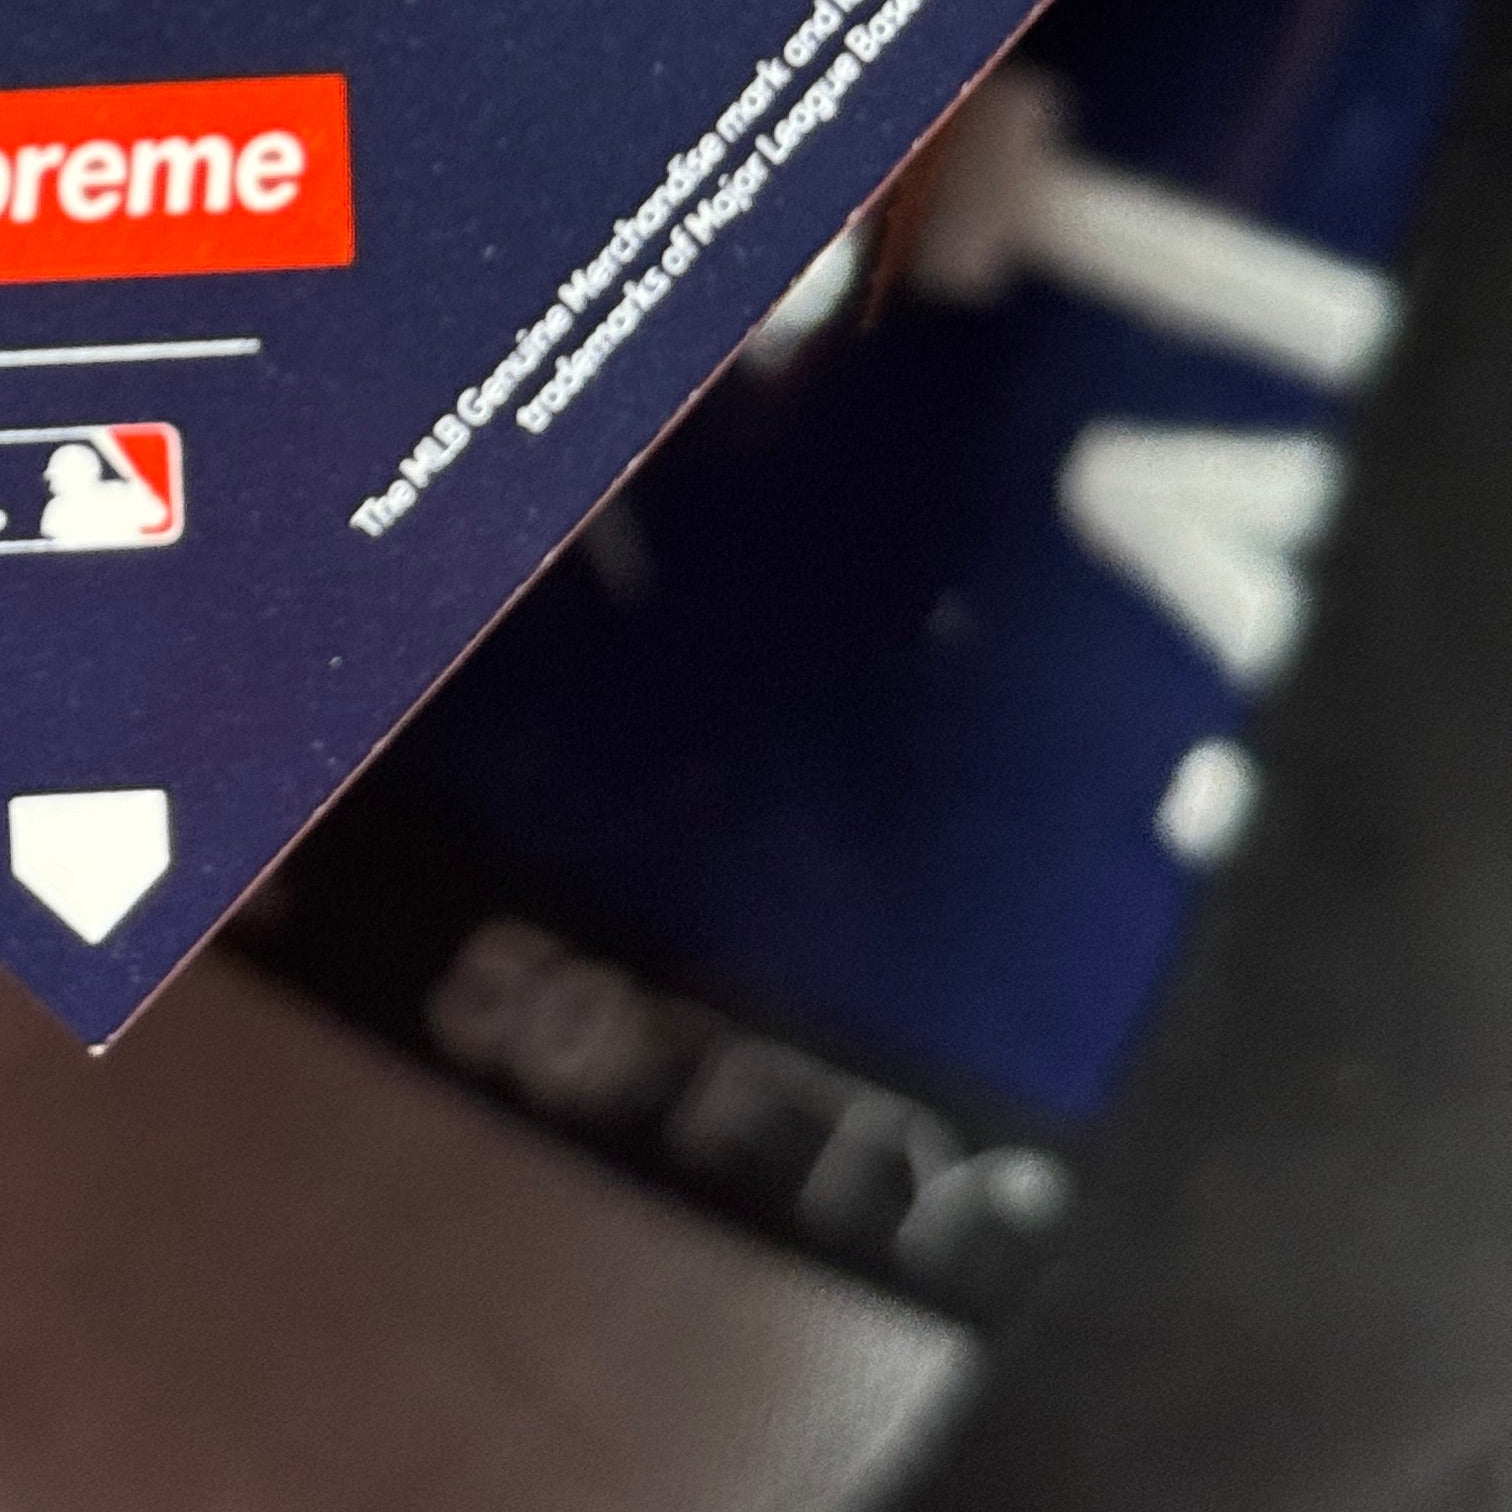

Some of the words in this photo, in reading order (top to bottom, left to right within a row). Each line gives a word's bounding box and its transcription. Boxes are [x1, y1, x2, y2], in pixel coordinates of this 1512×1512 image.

[350, 479, 418, 536] The
[399, 414, 471, 488] MLB
[457, 304, 573, 426] Genuine
[558, 133, 726, 313] Merchandise
[716, 58, 791, 142] mark
[516, 266, 671, 433] trademarks
[662, 225, 698, 277] of
[684, 152, 768, 245] Major
[755, 53, 861, 165] League
